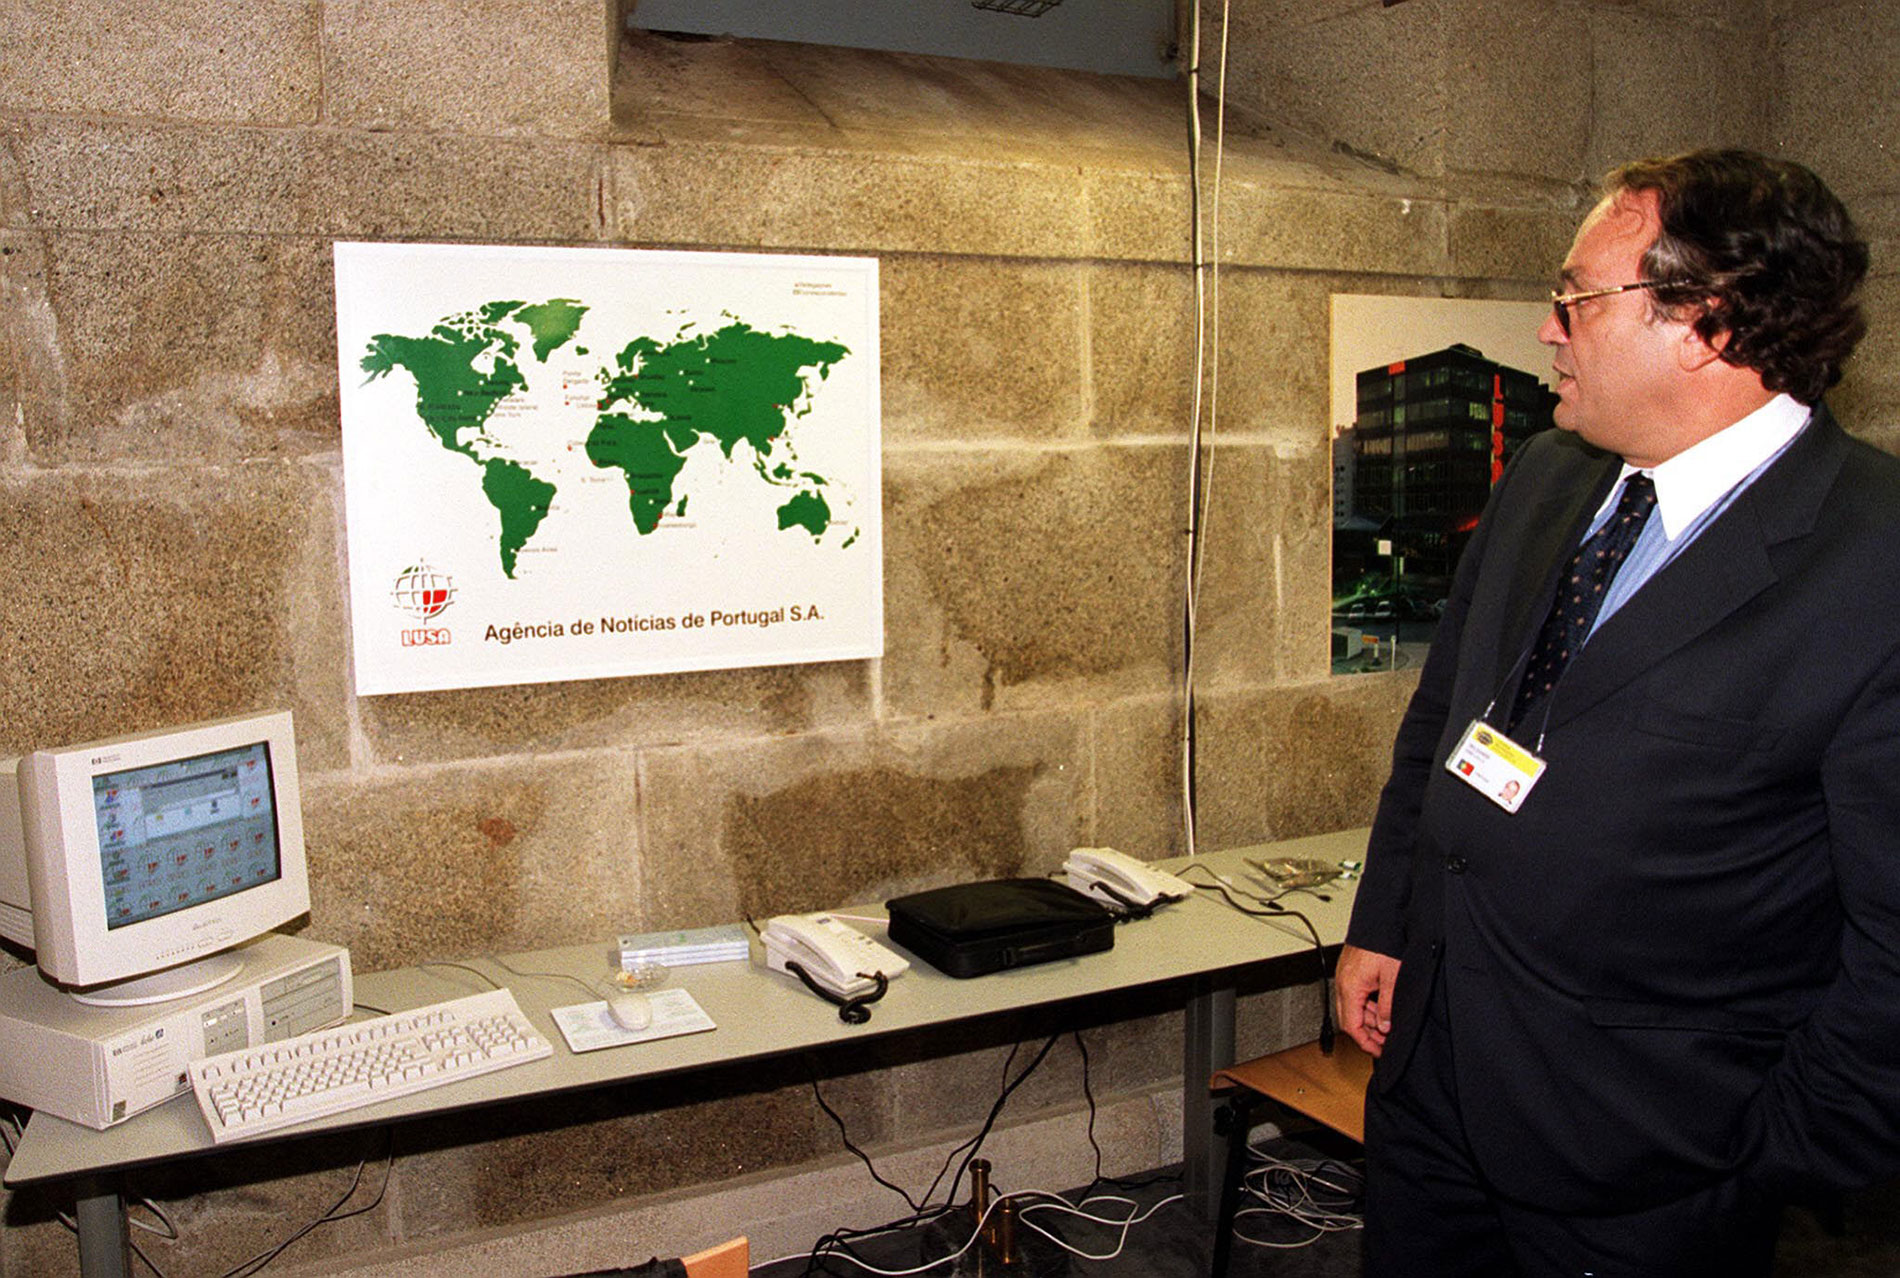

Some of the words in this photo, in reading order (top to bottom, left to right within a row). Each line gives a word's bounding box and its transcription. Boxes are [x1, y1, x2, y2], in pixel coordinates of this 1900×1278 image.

[401, 628, 452, 648] LUSA
[484, 621, 565, 645] Agência
[570, 619, 595, 636] de
[681, 612, 705, 629] de
[710, 607, 785, 628] Portugal
[789, 604, 825, 622] S.A.
